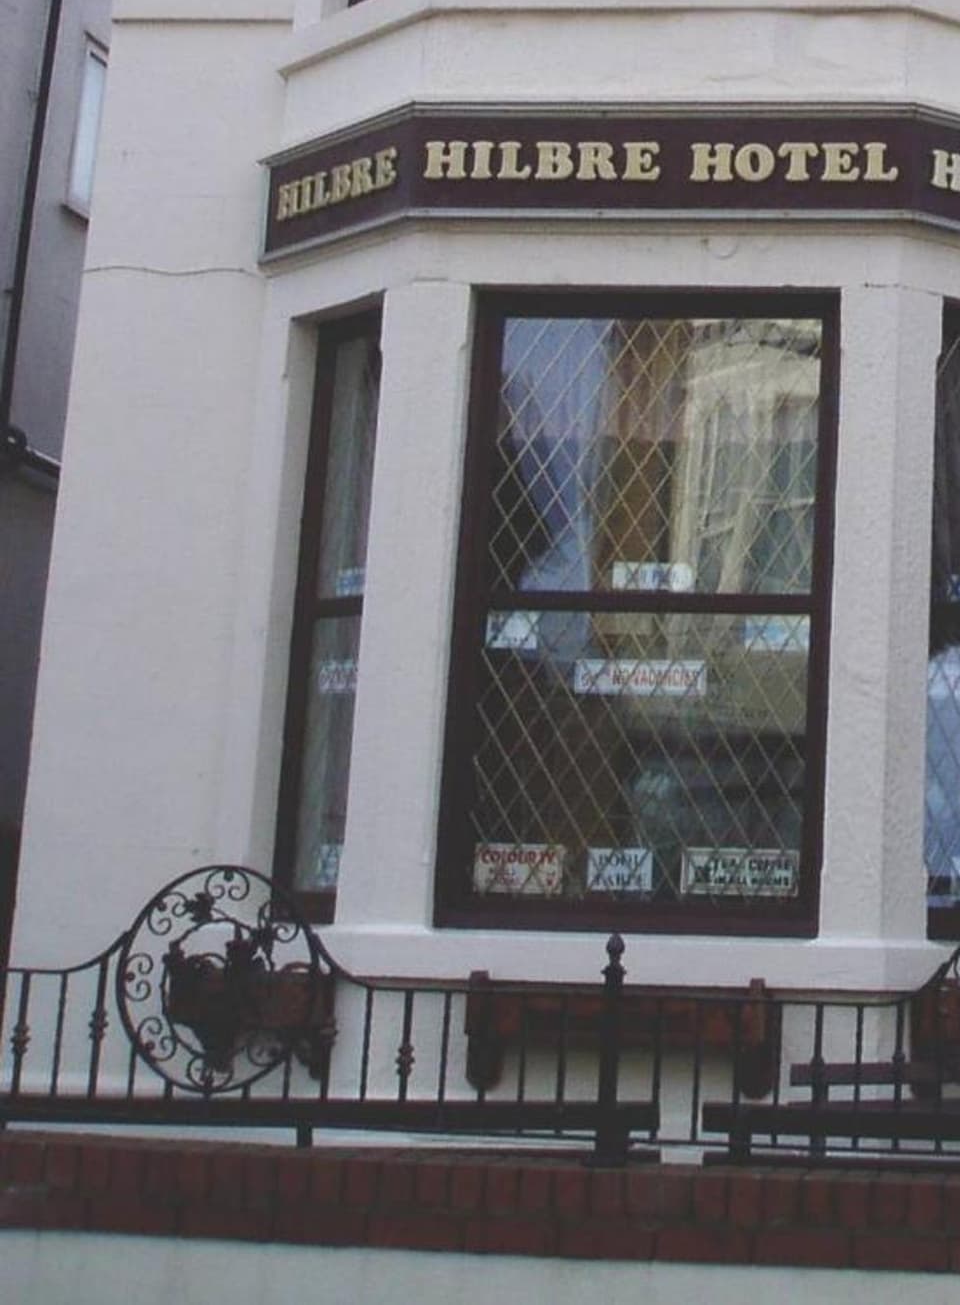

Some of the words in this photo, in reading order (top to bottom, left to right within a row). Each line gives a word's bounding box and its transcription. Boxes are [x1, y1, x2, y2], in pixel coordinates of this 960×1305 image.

[423, 141, 661, 182] HILBRE
[690, 141, 899, 183] HOTEL
[276, 147, 397, 221] HILBRE
[480, 849, 537, 864] COLOUR
